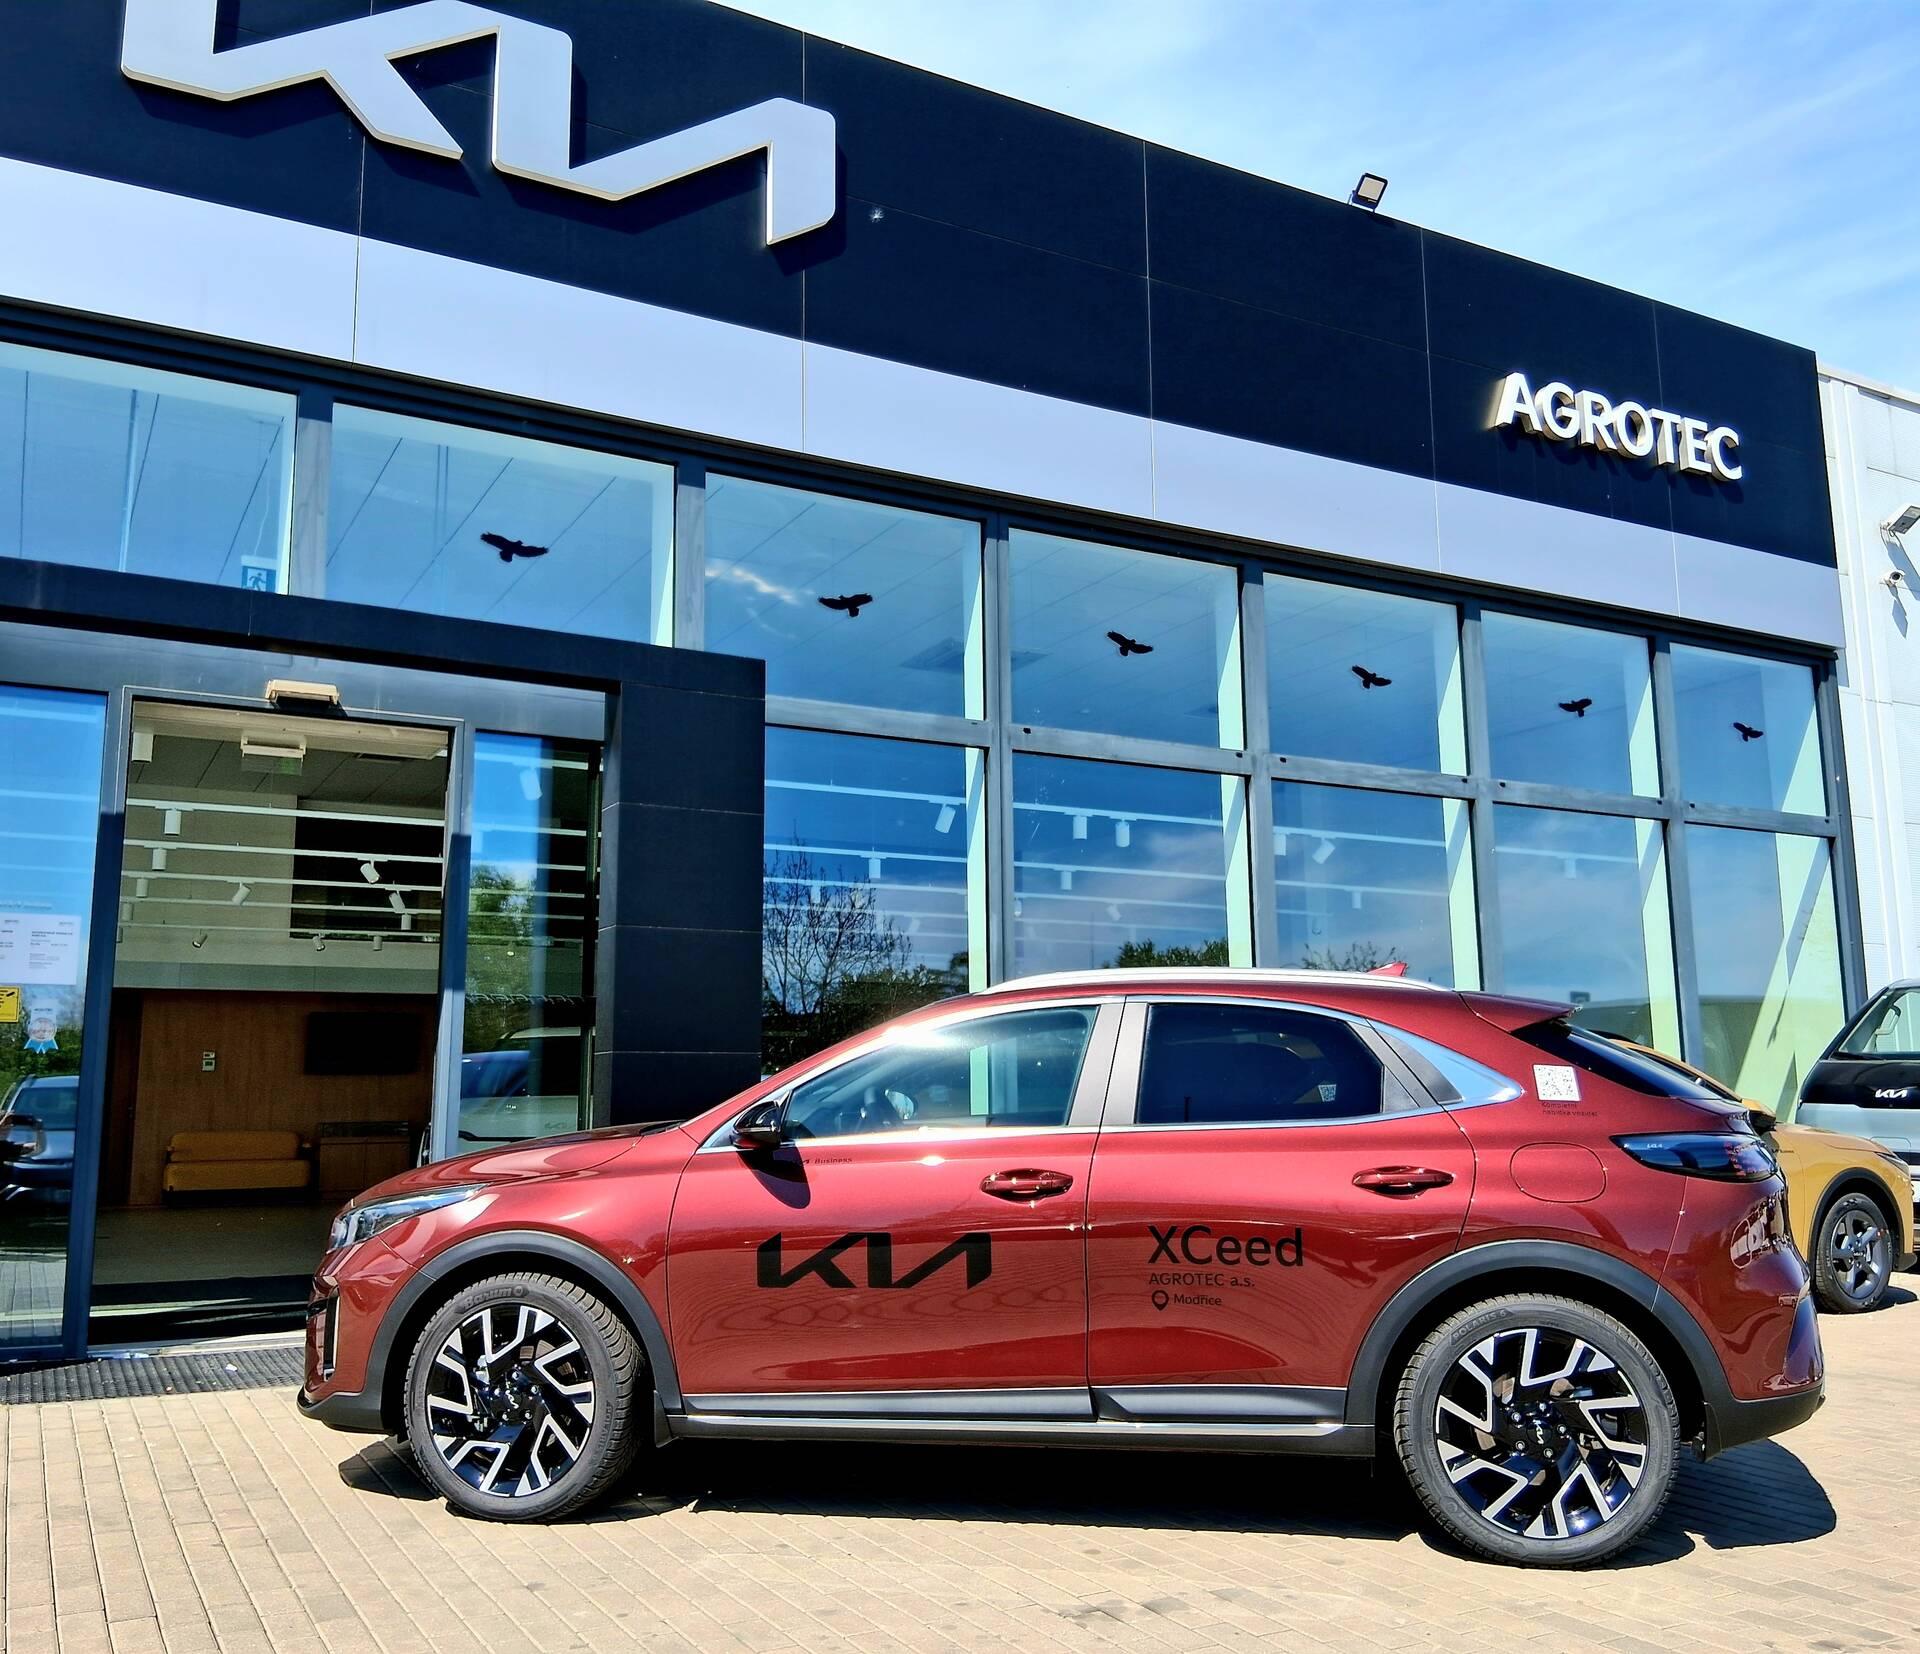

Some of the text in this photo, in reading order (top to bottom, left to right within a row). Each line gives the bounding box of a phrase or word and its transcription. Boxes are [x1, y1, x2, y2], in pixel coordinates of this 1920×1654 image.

[121, 0, 836, 246] KIA
[1487, 371, 1743, 481] AGROTEC
[1875, 1088, 1908, 1098] KIA
[757, 1231, 992, 1290] KIA
[1148, 1225, 1304, 1267] XCeed
[1149, 1272, 1256, 1287] AGROTEC a.s.
[1452, 1312, 1498, 1339] POLARIS
